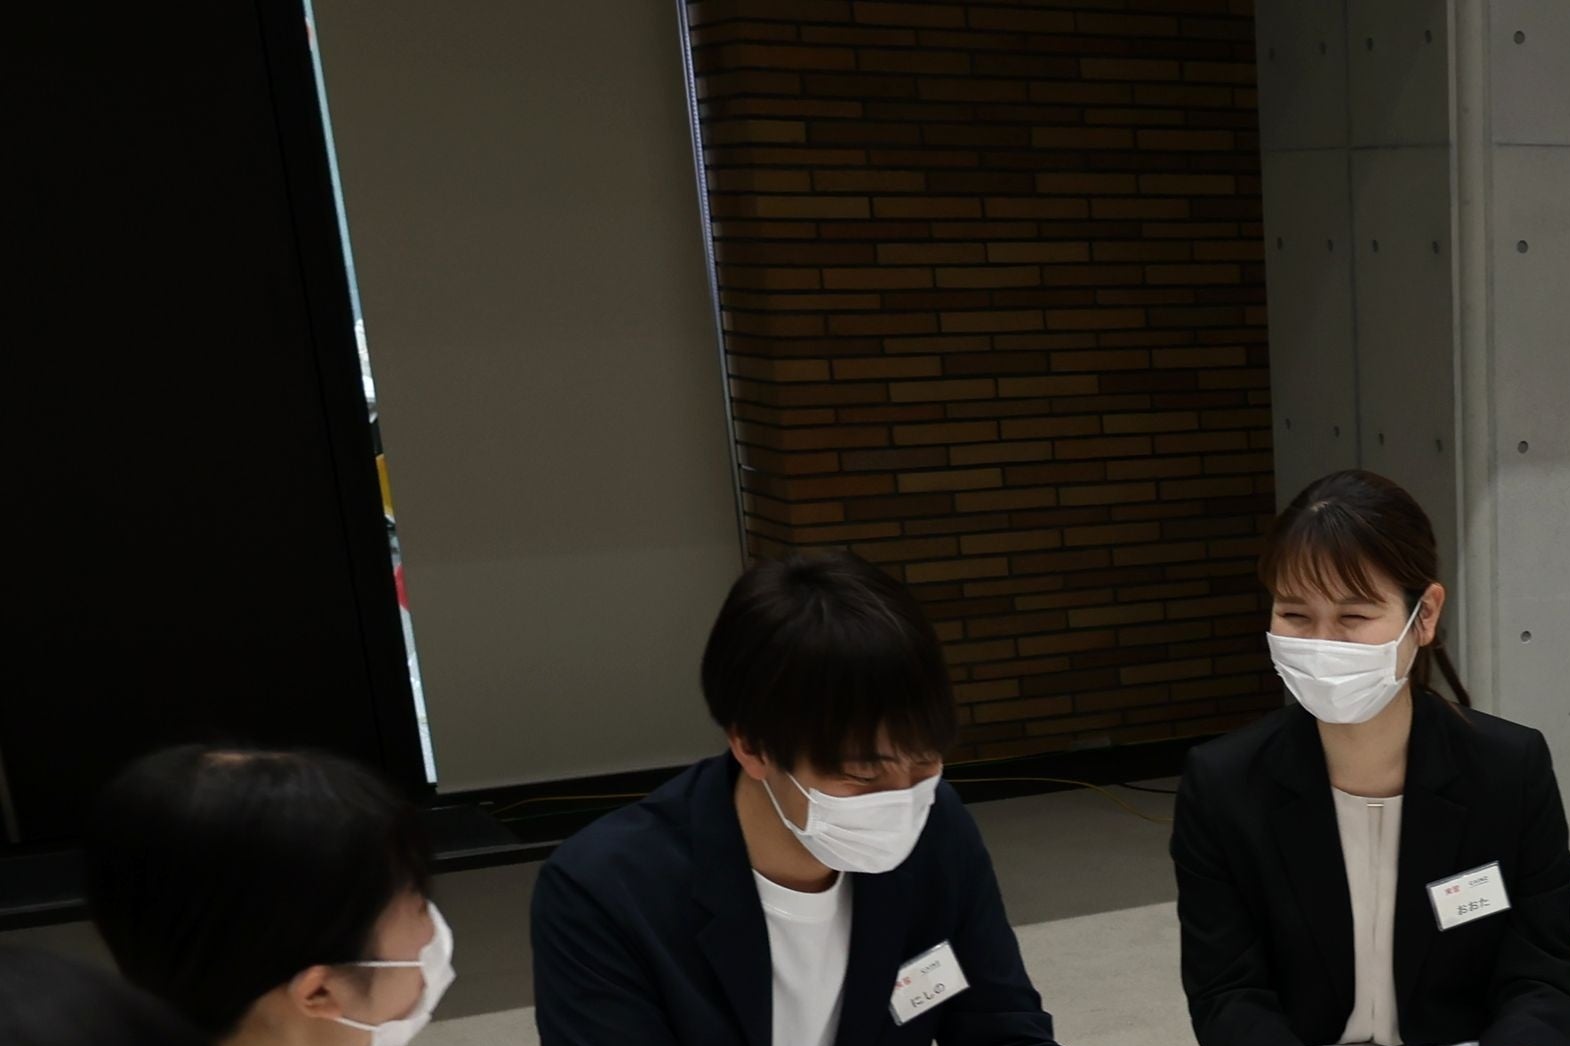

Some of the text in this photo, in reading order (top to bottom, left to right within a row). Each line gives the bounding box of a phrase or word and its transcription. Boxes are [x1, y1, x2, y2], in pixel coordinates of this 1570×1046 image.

[1456, 898, 1491, 916] おおた
[910, 983, 945, 1008] にしの
